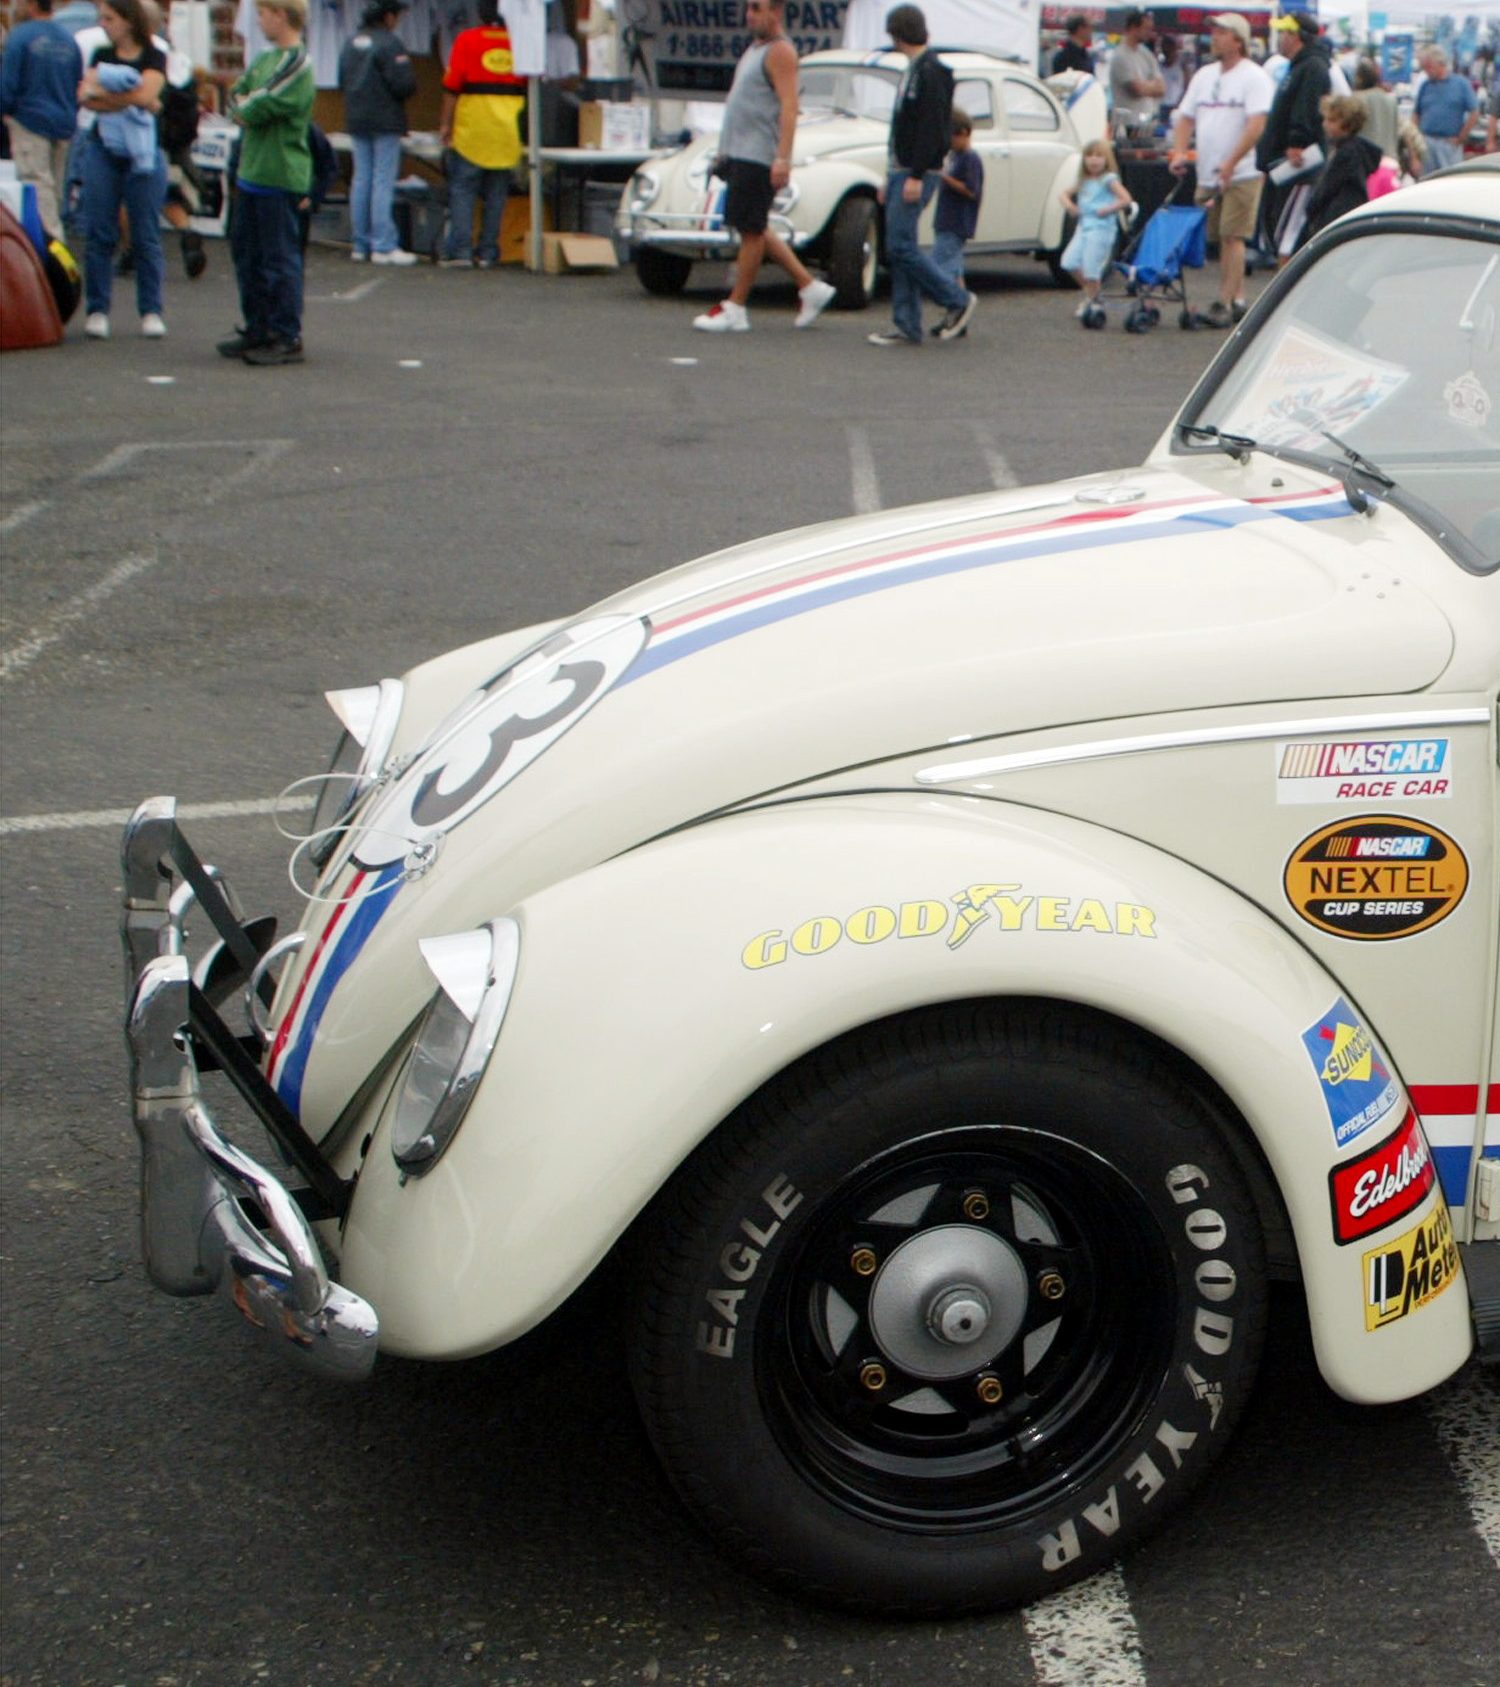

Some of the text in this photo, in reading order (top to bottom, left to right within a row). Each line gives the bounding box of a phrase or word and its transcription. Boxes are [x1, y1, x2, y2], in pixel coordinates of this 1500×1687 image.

[786, 0, 847, 29] PAR
[1329, 742, 1439, 775] NASCAR
[1336, 779, 1449, 799] RACE CAR
[1355, 836, 1426, 856] NASCAR
[1309, 866, 1447, 894] NEXTEL
[1323, 901, 1425, 916] CUP SERIES
[699, 1172, 804, 1359] EAGLE
